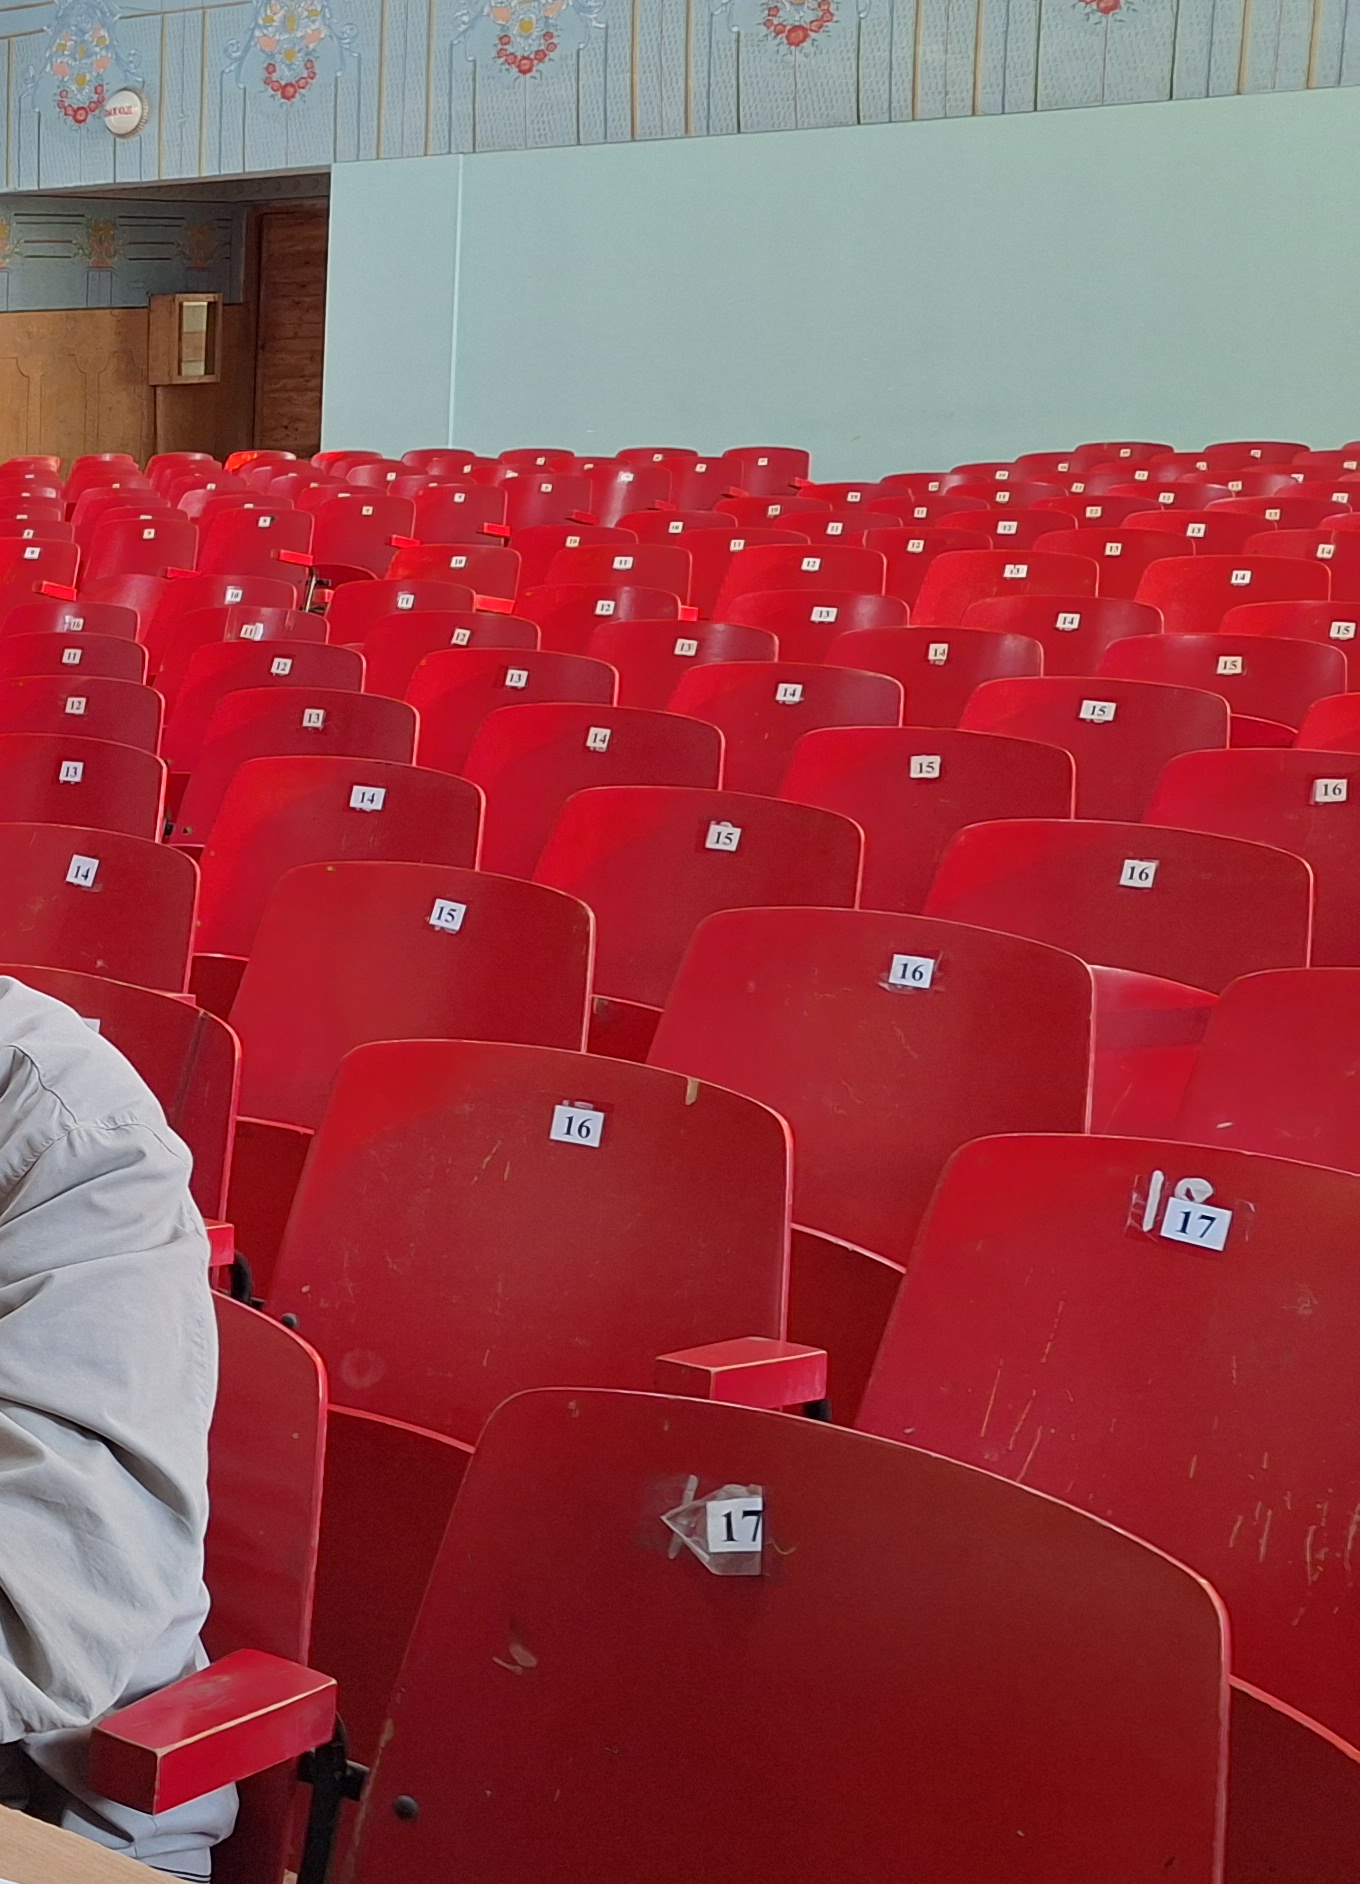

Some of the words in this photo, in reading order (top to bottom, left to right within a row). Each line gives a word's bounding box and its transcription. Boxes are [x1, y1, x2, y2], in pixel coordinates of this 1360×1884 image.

[1109, 545, 1119, 553] 13
[1321, 547, 1332, 555] 14
[454, 558, 463, 566] 10
[806, 560, 817, 568] 12
[1234, 573, 1246, 581] 14
[230, 591, 240, 600] 10
[400, 597, 410, 606] 11
[600, 603, 611, 612] 12
[818, 610, 830, 619] 13
[1062, 616, 1075, 626] 14
[241, 625, 255, 638] 11
[1336, 625, 1351, 635] 15
[456, 632, 467, 642] 12
[680, 642, 692, 652] 13
[67, 652, 77, 661] 11
[933, 648, 946, 658] 14
[276, 661, 288, 672] 12
[1223, 660, 1238, 671] 15
[509, 673, 522, 683] 13
[783, 687, 797, 698] 14
[70, 700, 82, 711] 12
[1090, 705, 1107, 717] 15
[307, 713, 320, 724] 13
[592, 732, 608, 745] 14
[65, 766, 78, 778] 13
[918, 761, 935, 774] 15
[1323, 783, 1342, 797] 16
[360, 791, 376, 805] 14
[715, 831, 734, 845] 15
[74, 865, 91, 881] 14
[1128, 865, 1150, 882] 16
[436, 906, 457, 923] 15
[900, 962, 924, 982] 16
[564, 1115, 591, 1139] 16
[1175, 1210, 1217, 1239] 17
[721, 1508, 764, 1543] 17
